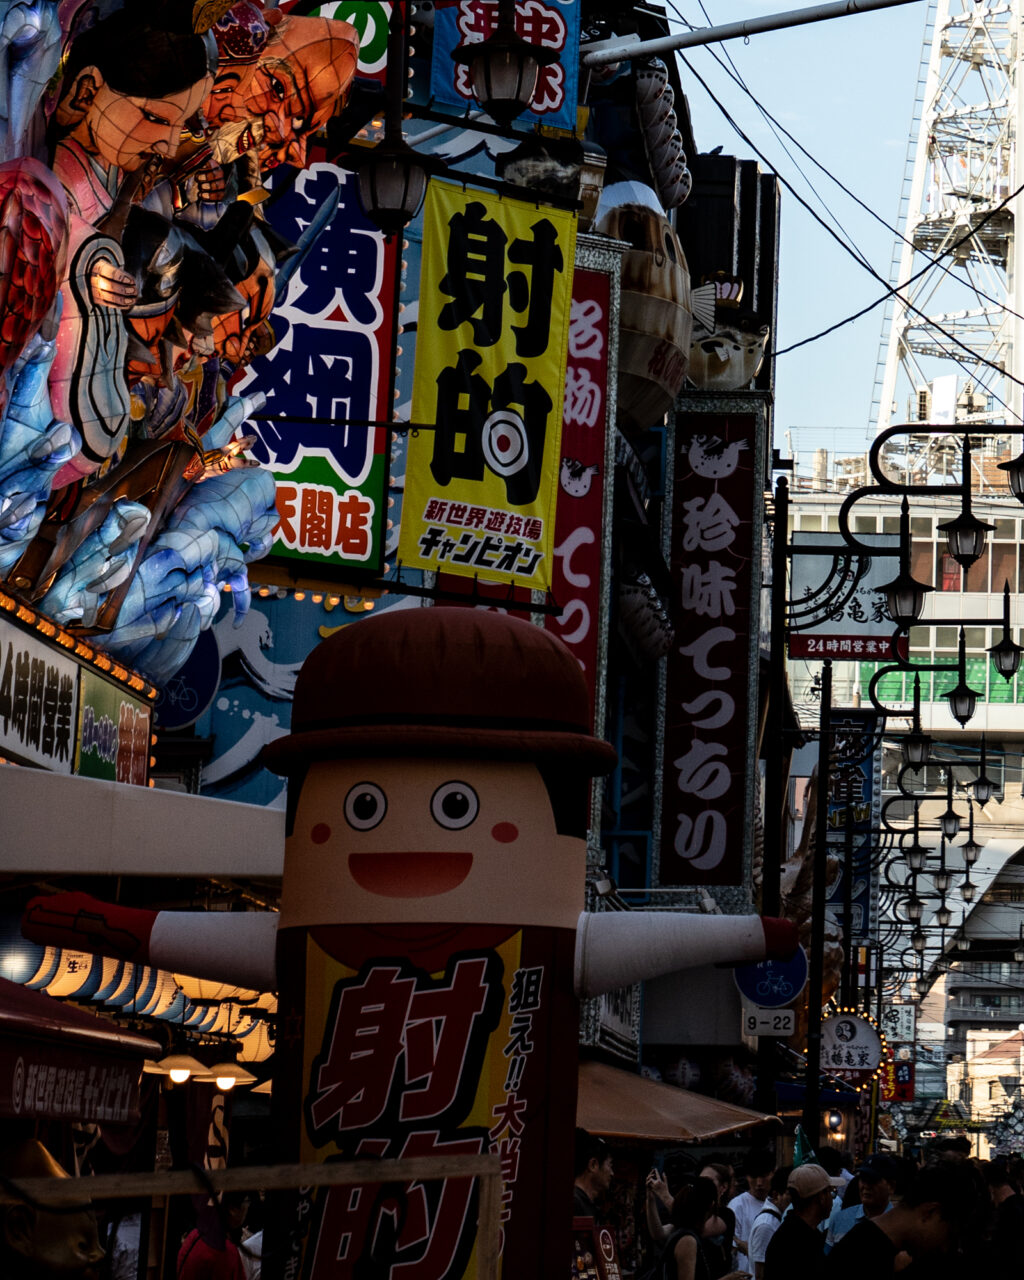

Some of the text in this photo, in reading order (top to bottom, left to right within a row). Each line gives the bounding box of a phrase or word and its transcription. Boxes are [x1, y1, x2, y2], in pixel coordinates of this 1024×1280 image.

[429, 200, 564, 507] 射的
[424, 500, 543, 541] 新世界遊技場
[418, 528, 545, 576] チャンピオン
[807, 639, 890, 653] 24時間営業中
[748, 1016, 791, 1030] 9-22
